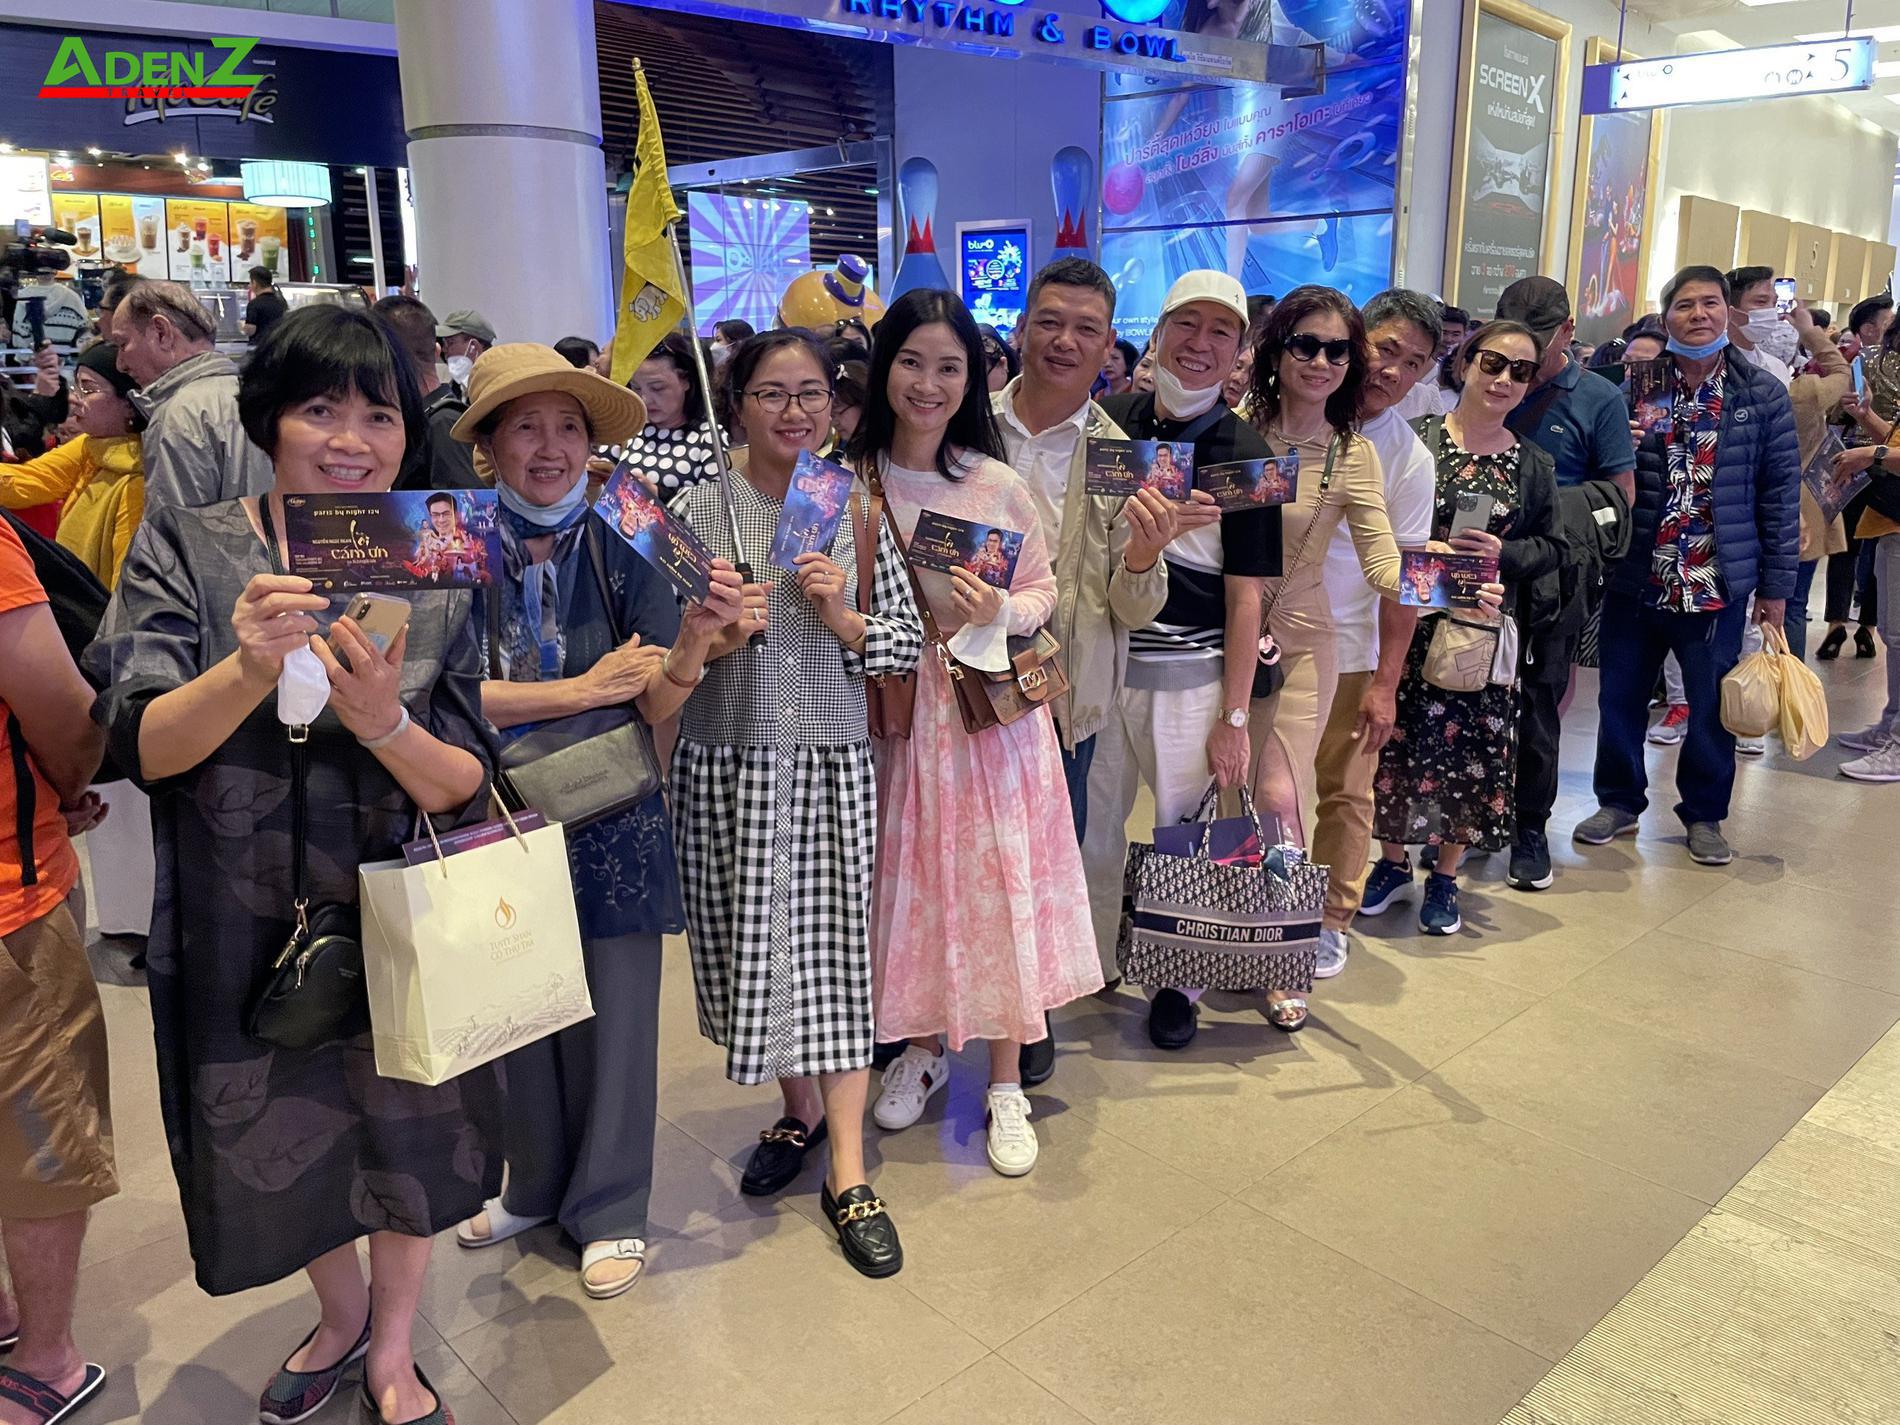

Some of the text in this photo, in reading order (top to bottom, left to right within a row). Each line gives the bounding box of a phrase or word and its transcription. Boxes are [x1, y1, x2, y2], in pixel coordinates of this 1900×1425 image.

[846, 0, 1014, 37] RHYTHM
[1038, 13, 1064, 43] &
[1089, 25, 1186, 62] BOWL
[1830, 48, 1852, 81] 5
[1256, 108, 1330, 145] คาราโอเกะ
[1176, 920, 1283, 942] CHRISTIAN DIOR
